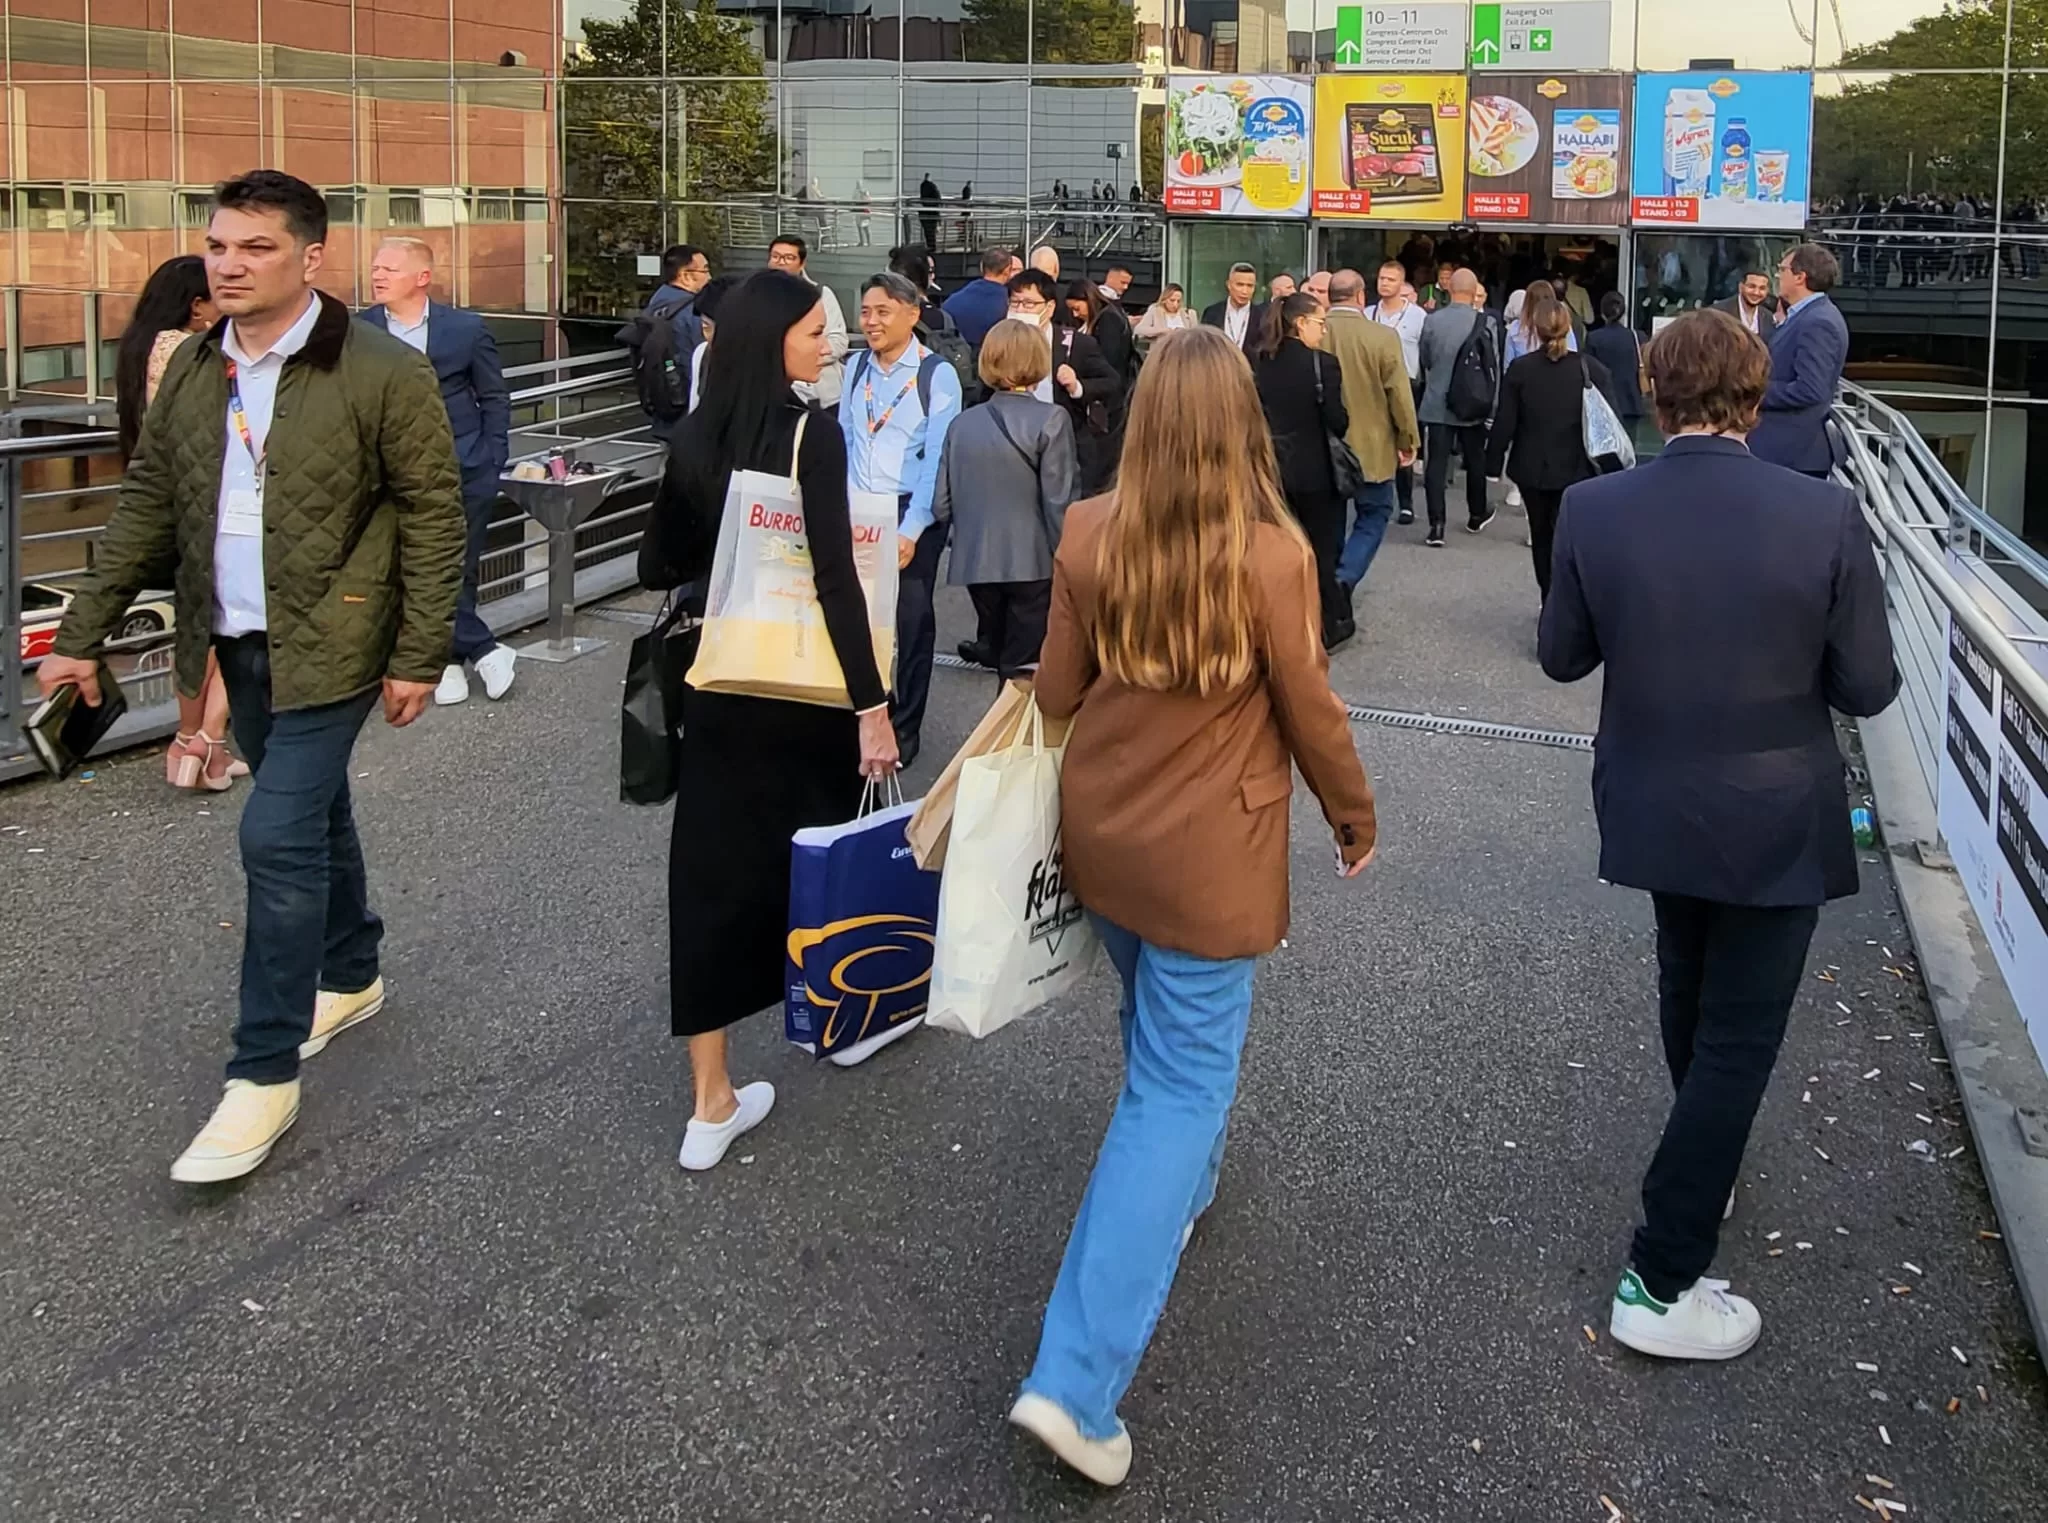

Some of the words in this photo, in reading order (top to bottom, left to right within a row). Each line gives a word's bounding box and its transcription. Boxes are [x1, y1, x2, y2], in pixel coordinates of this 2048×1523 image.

[1367, 11, 1385, 24] 10
[1401, 10, 1417, 24] 11
[1505, 8, 1537, 17] Ausgang
[1434, 28, 1448, 36] Ost
[1366, 38, 1397, 47] Congress
[1369, 130, 1419, 146] Sucuk
[1173, 190, 1196, 198] HALLE
[1318, 192, 1343, 200] HALLE
[1474, 196, 1501, 204] HALLE
[1640, 199, 1668, 208] HALLE
[1318, 201, 1344, 209] STAND
[1640, 208, 1668, 217] STAND
[749, 503, 803, 534] BURRO
[853, 525, 881, 543] OLI
[2003, 687, 2014, 723] Hall
[2014, 701, 2022, 735] 5.2
[2026, 717, 2043, 762] Stand
[2001, 797, 2010, 837] Hall
[2010, 815, 2021, 856] 11.1
[2025, 840, 2041, 890] Stand
